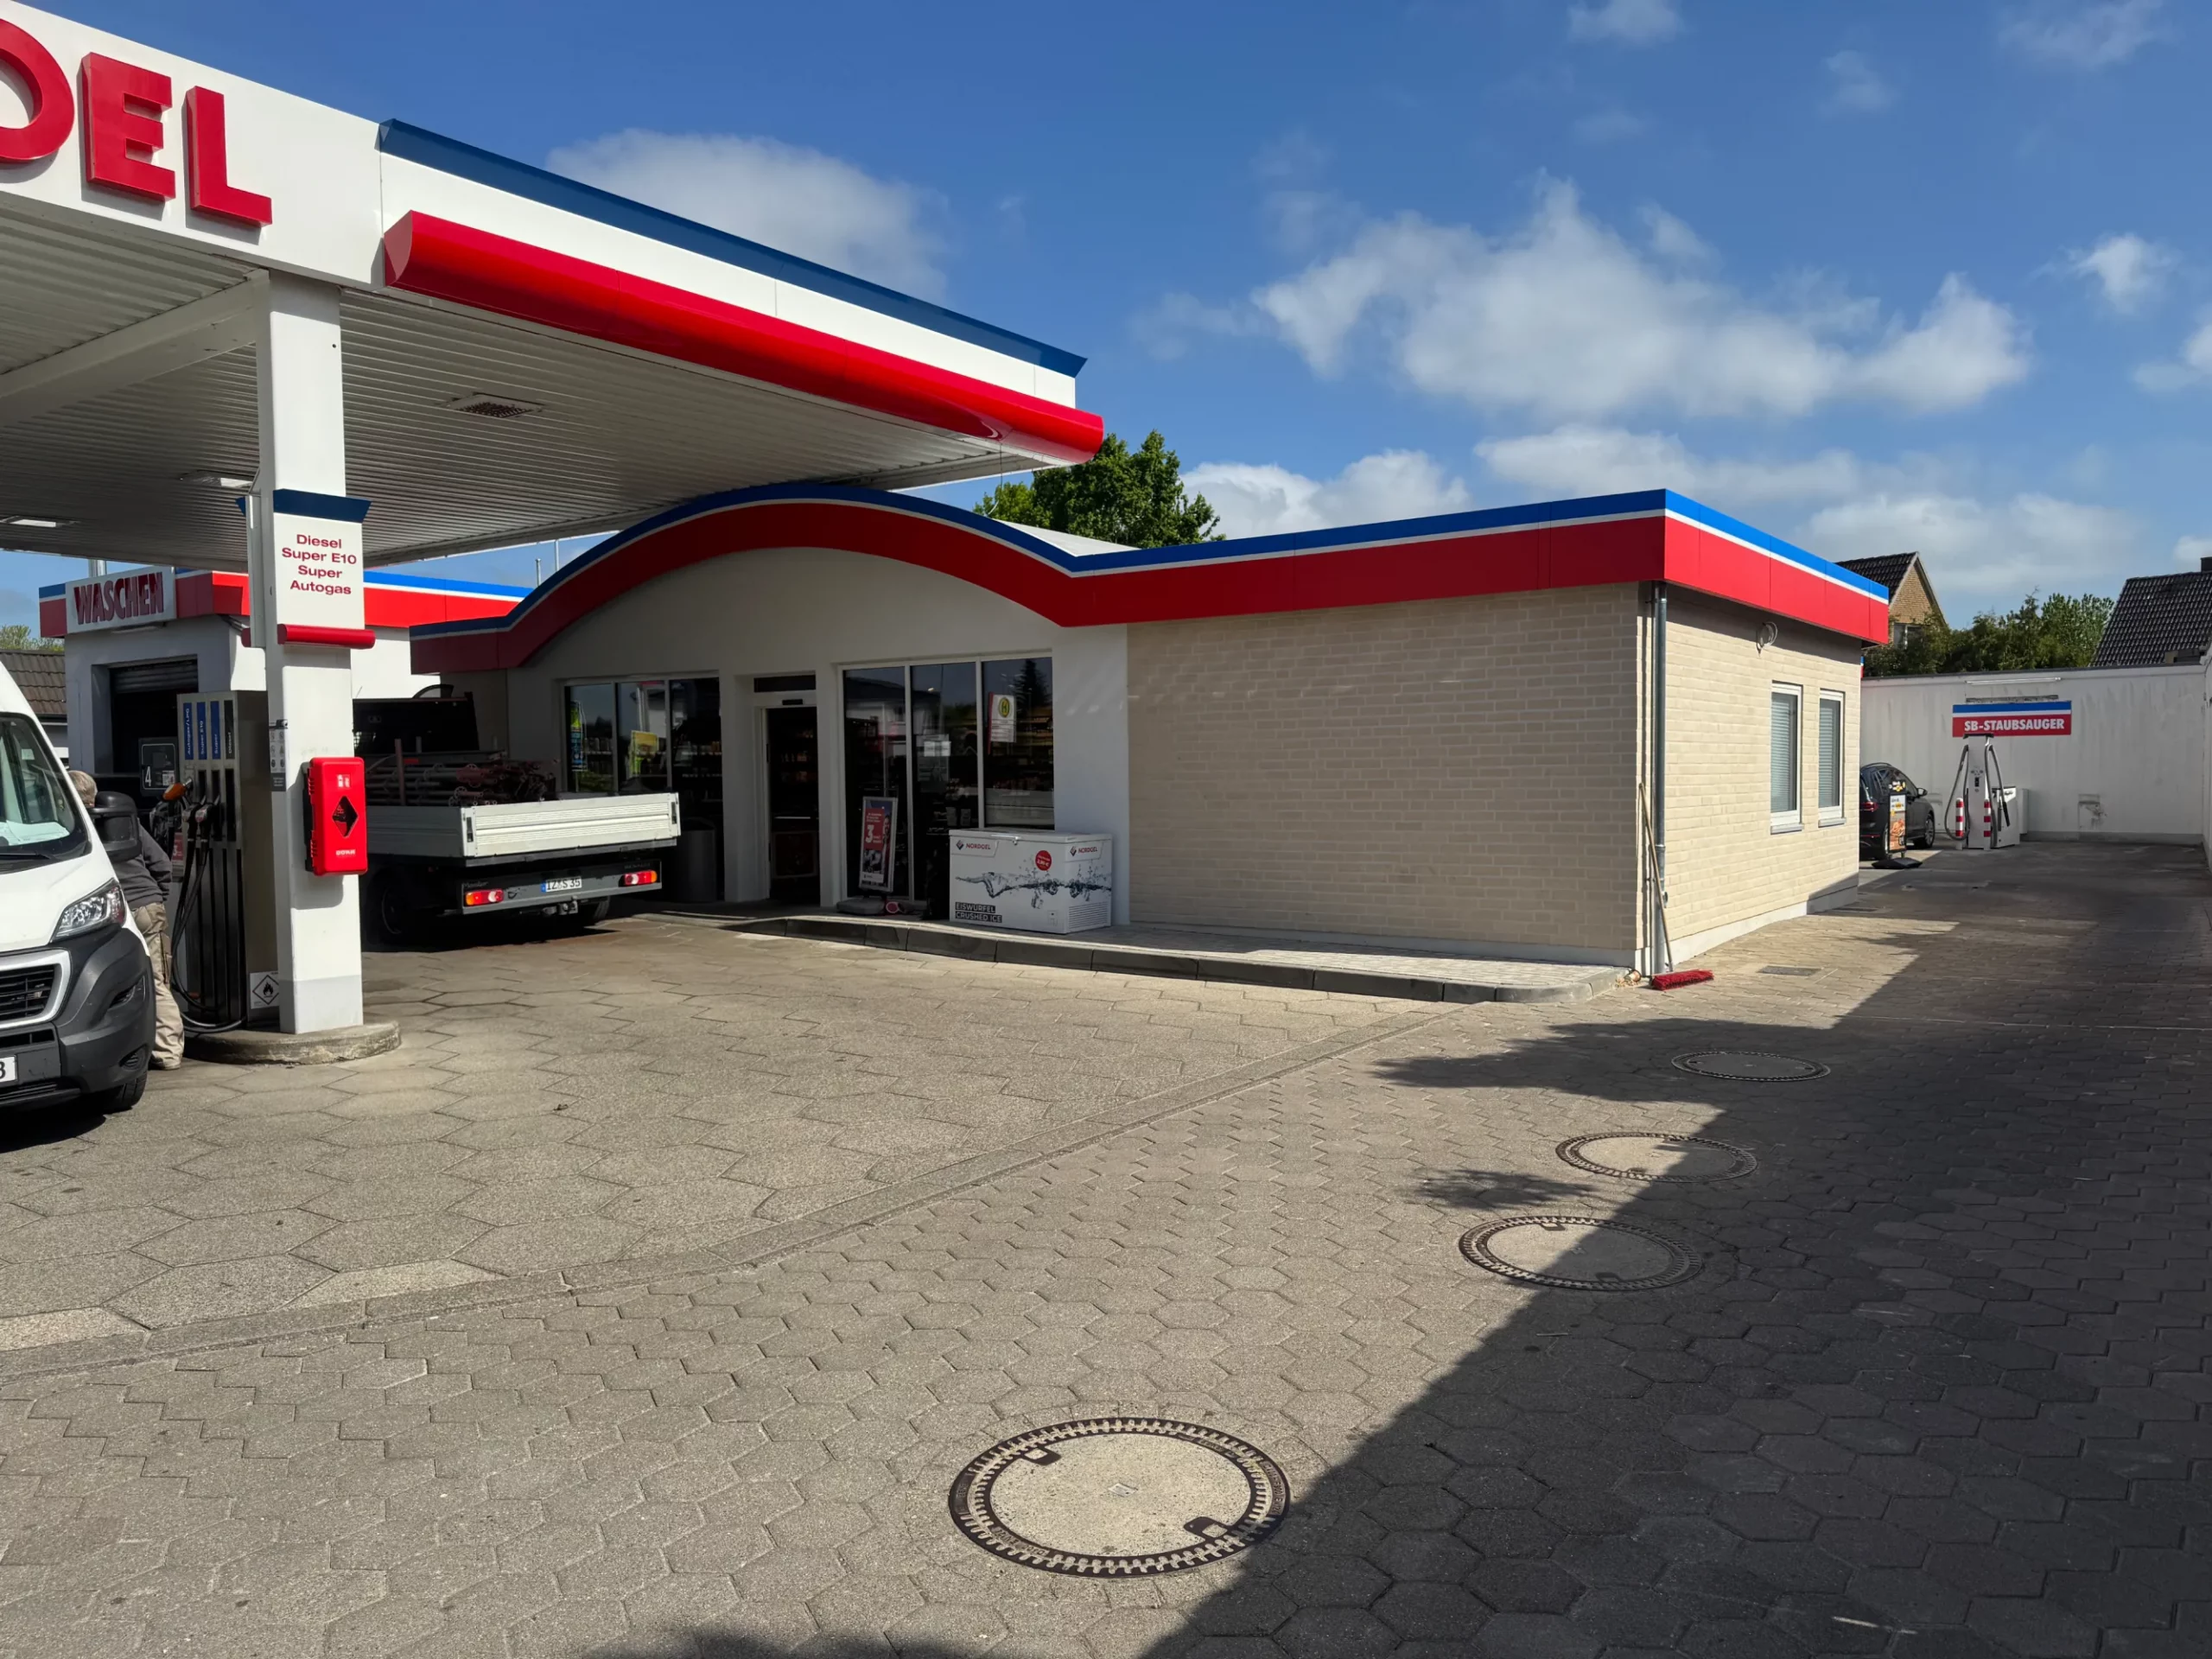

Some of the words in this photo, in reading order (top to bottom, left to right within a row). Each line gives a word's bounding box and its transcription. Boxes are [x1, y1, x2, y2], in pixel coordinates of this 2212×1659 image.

[296, 534, 342, 549] Diesel
[282, 547, 327, 562] Super
[332, 552, 357, 564] E10
[297, 564, 343, 579] Super
[289, 580, 352, 595] Autogas
[73, 571, 164, 625] WASCHEN
[1964, 718, 2065, 731] SB-STAUBSAUGER
[144, 766, 152, 787] 4
[865, 824, 874, 843] 3
[956, 912, 988, 921] CRUSHED
